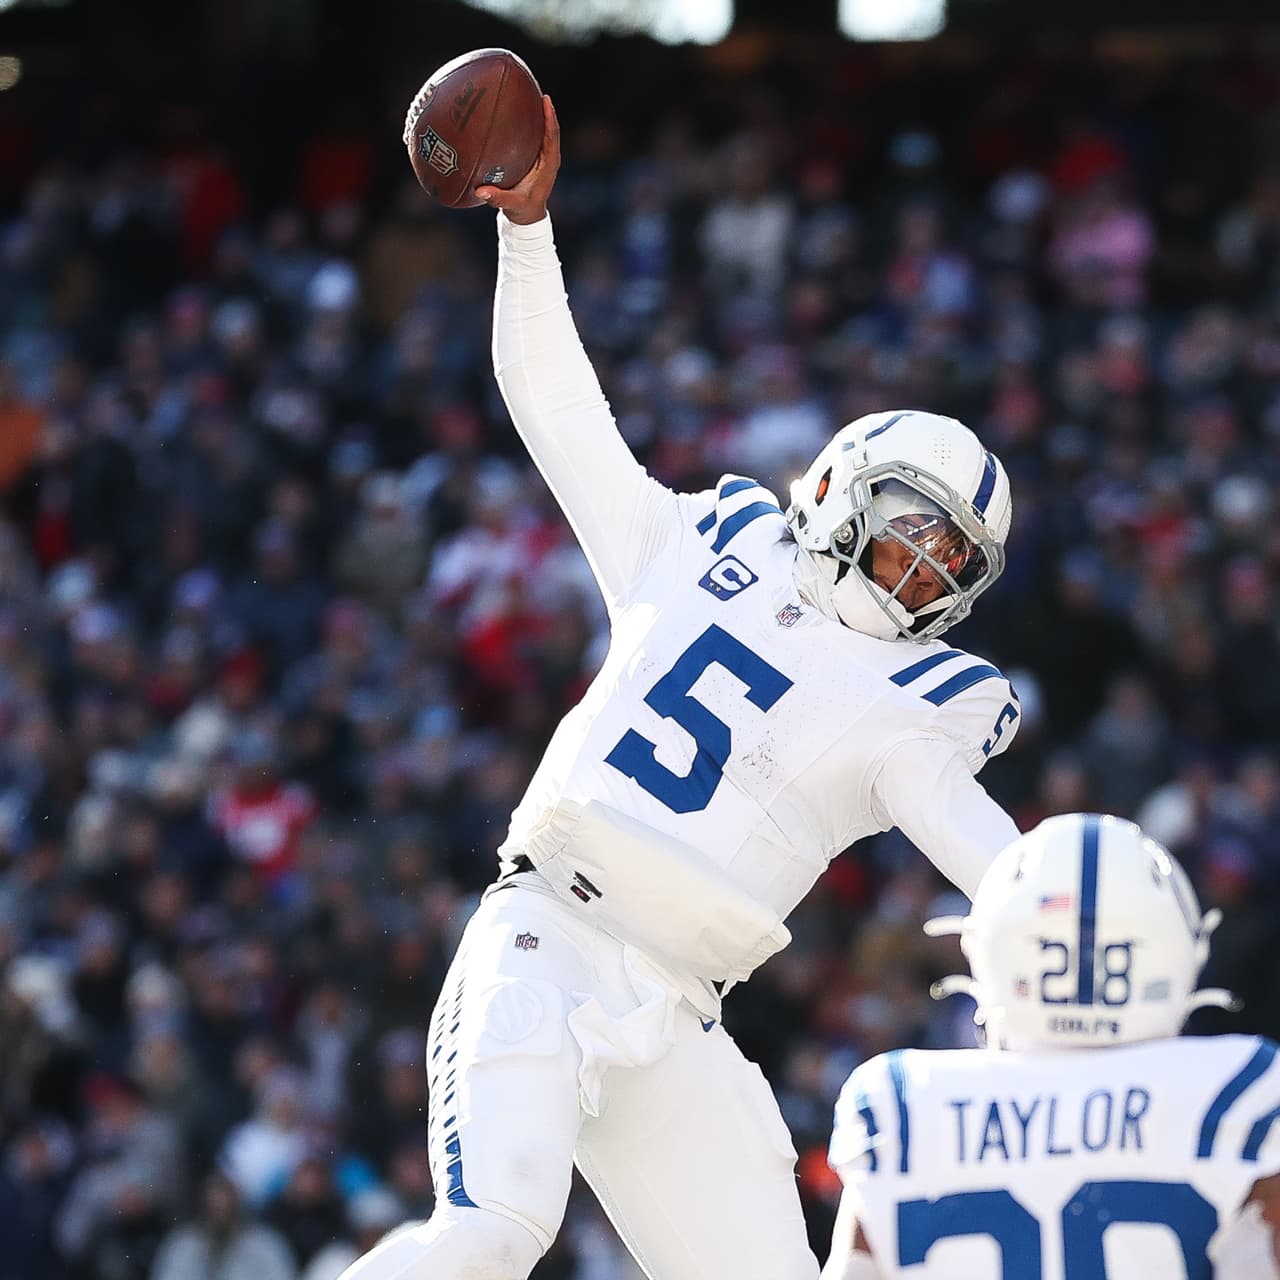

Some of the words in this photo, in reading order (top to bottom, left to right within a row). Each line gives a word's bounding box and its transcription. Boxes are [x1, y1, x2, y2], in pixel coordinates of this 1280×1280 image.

[709, 559, 752, 591] C
[603, 623, 795, 814] 5
[982, 702, 1019, 757] 5
[1040, 940, 1131, 1005] 28
[951, 1088, 1151, 1161] TAYLOR
